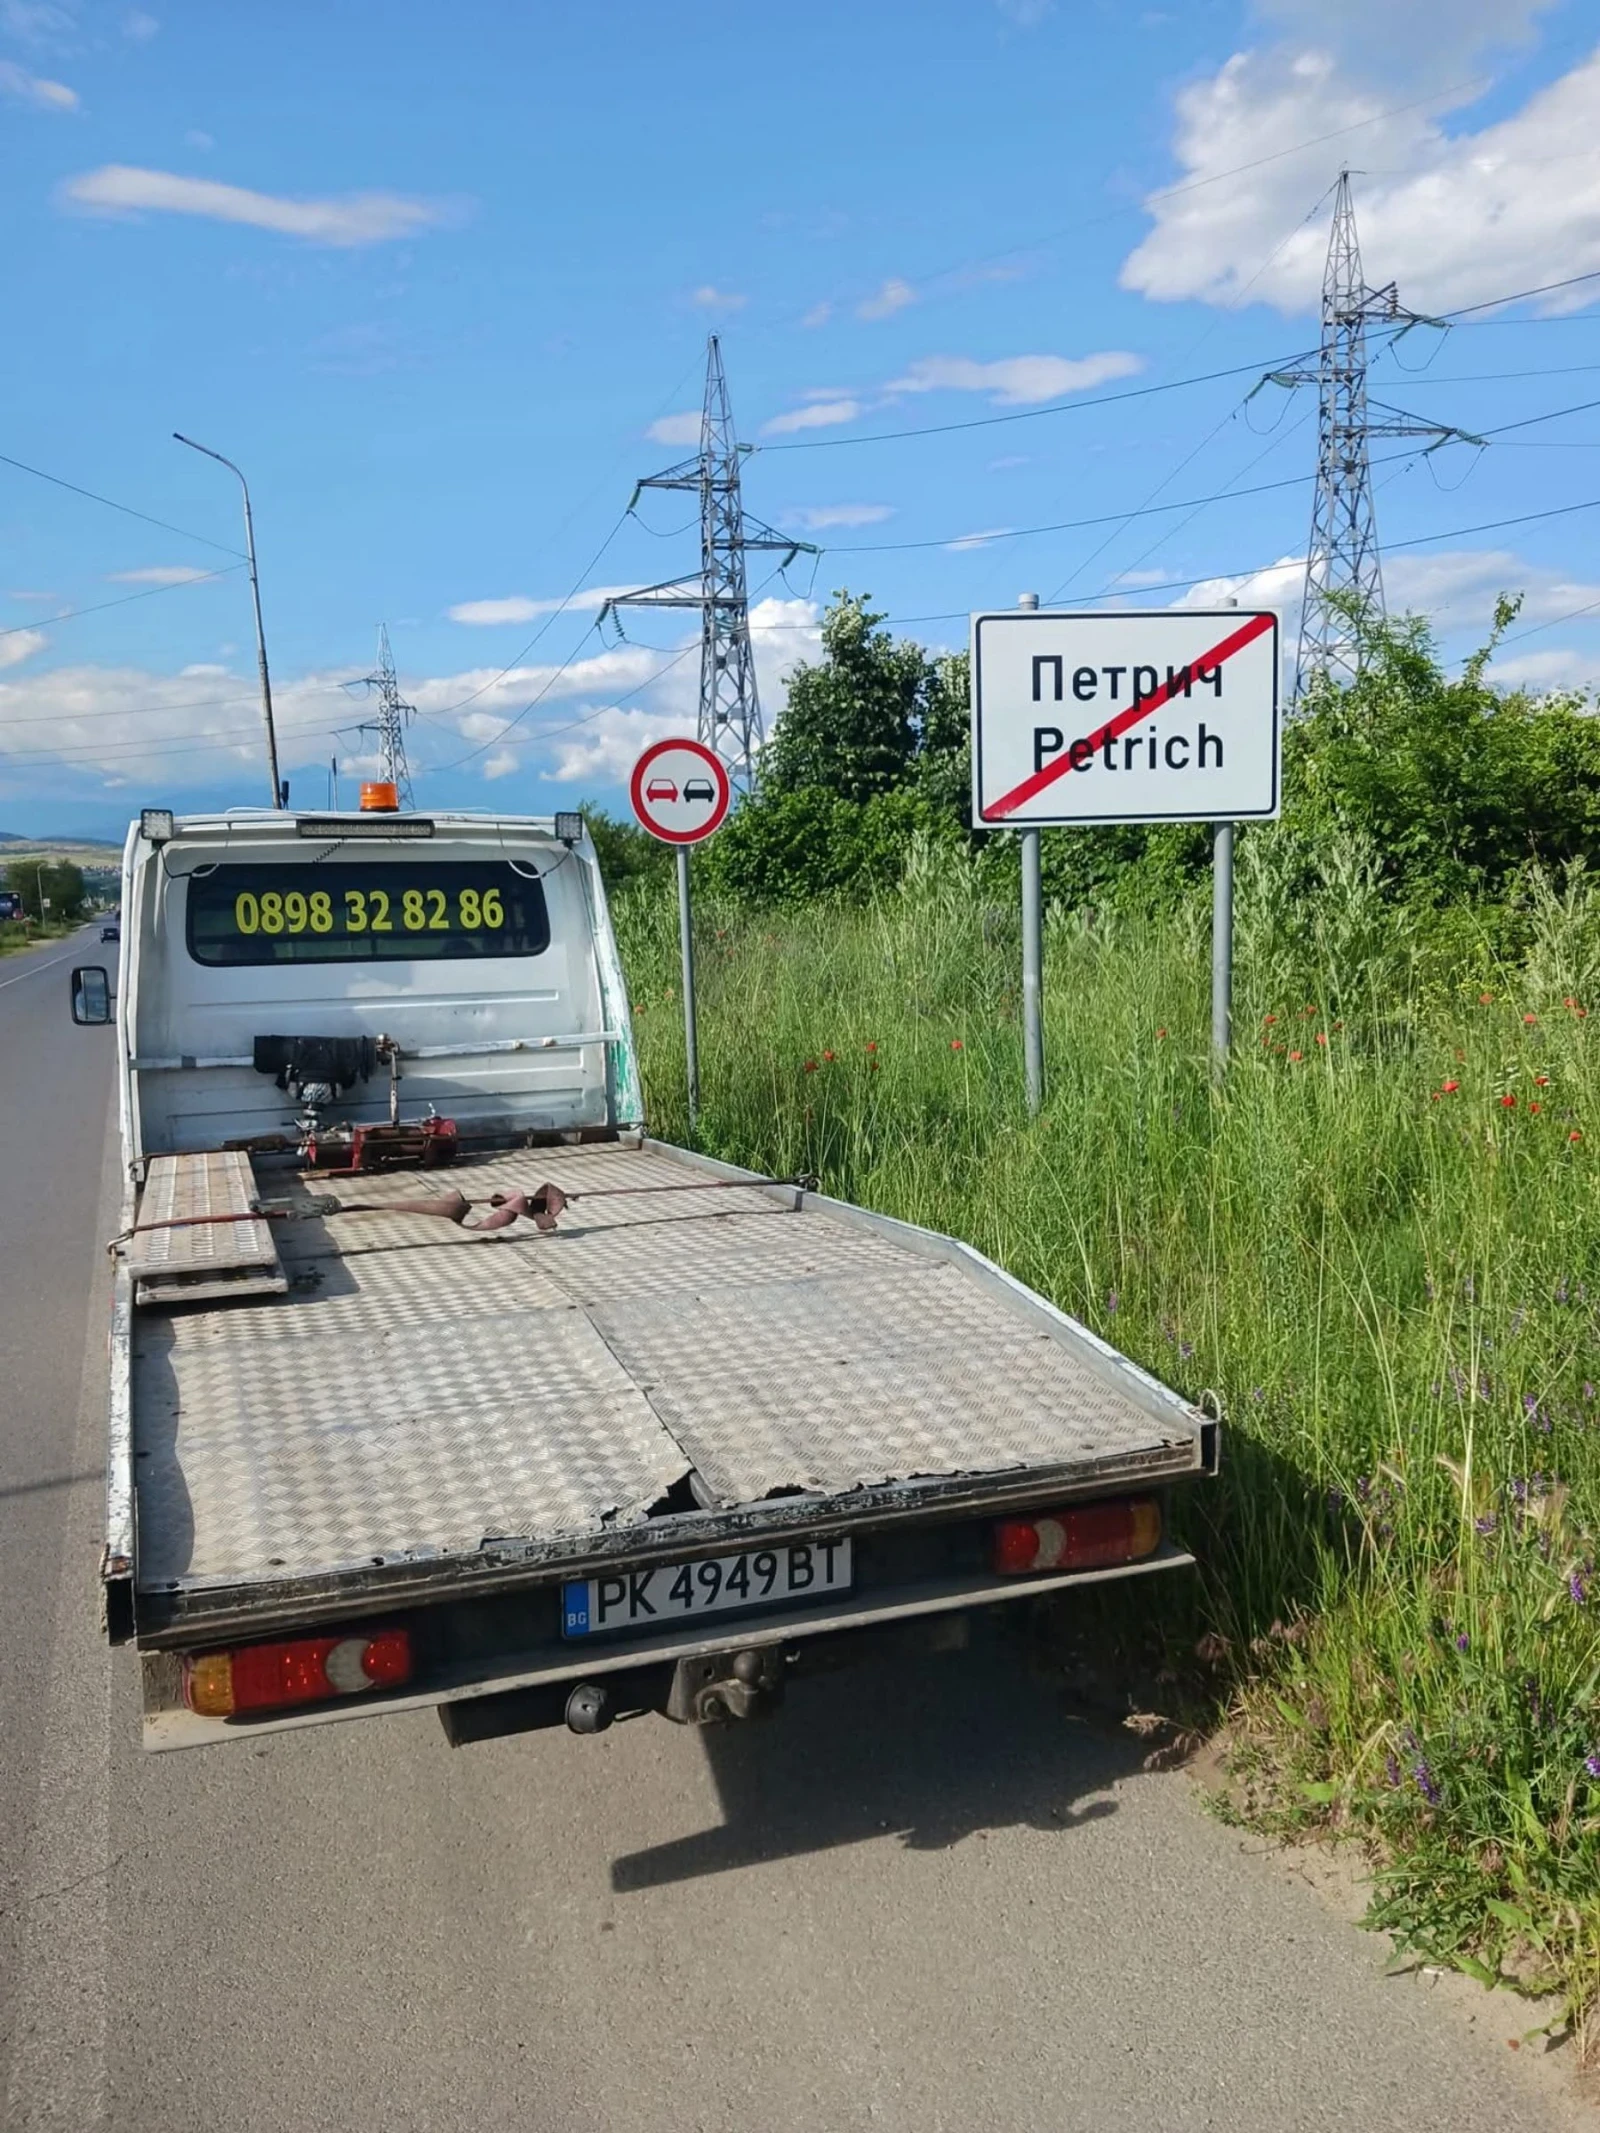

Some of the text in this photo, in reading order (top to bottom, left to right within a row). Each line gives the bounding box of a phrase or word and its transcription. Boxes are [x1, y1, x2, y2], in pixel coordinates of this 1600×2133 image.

[1031, 655, 1223, 712] Петрич
[1033, 723, 1224, 773] Petrich
[235, 888, 504, 934] 0898 32 82 86
[668, 1551, 778, 1609] 4949
[566, 1612, 587, 1628] BG
